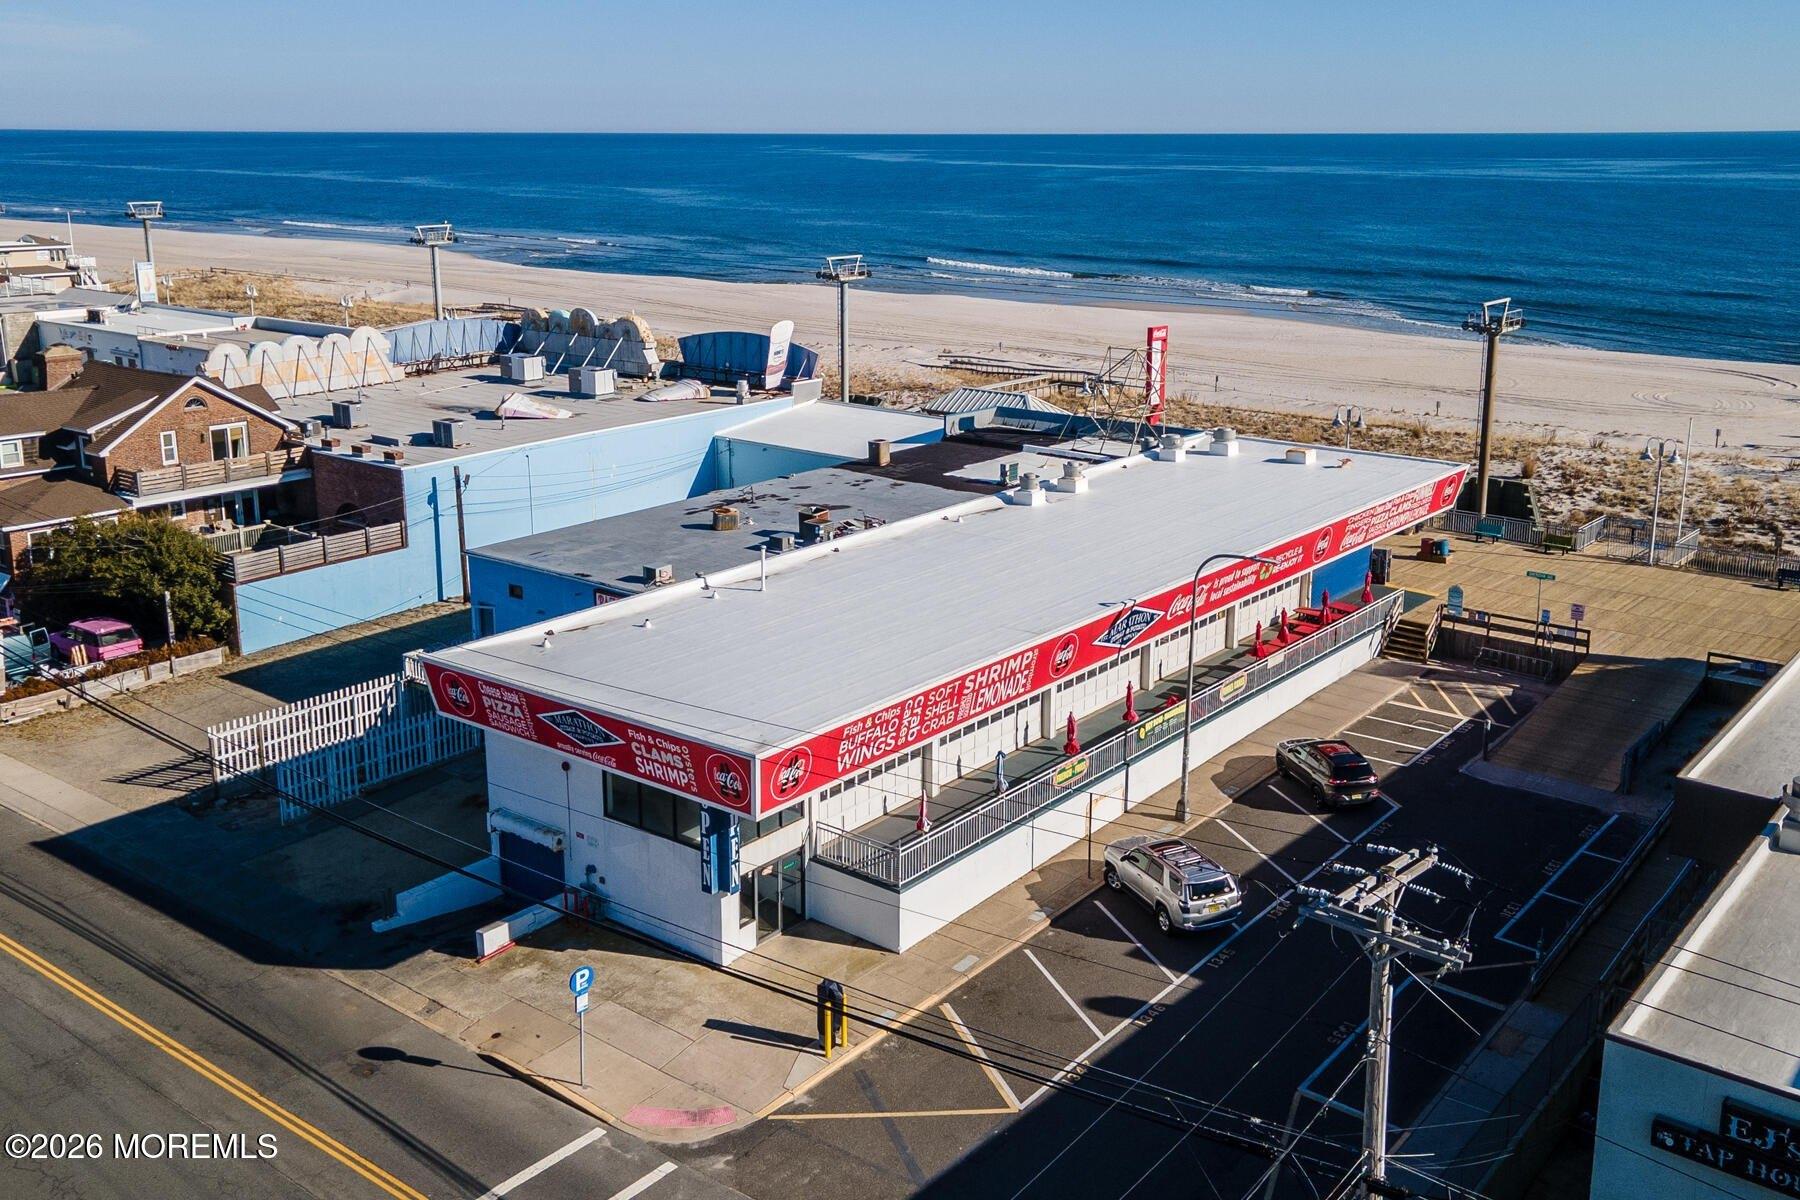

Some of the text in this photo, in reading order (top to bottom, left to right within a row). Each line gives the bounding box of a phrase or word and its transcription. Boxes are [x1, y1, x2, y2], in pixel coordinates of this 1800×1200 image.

[1389, 500, 1412, 516] CLAMS
[1210, 574, 1257, 602] local sustainability
[1218, 570, 1236, 588] proud
[1241, 563, 1261, 579] support
[963, 651, 1034, 694] SHRIMP
[477, 680, 502, 697] Cheese
[927, 680, 961, 704] SOFT
[969, 669, 1030, 715] LEMONADE
[482, 696, 525, 719] PIZZA
[485, 708, 529, 729] SAUSAGE
[924, 696, 959, 720] SHELL
[489, 718, 531, 737] SANDWICH
[554, 714, 606, 738] MARATHON
[842, 706, 901, 738] Fish & Chips
[921, 711, 955, 735] CRAB
[627, 728, 681, 754] Fish & Chips
[838, 718, 899, 755] BUFFALO
[631, 741, 685, 769] CLAMS
[836, 733, 897, 773] WINGS
[635, 756, 689, 787] SHRIMP
[681, 745, 698, 793] Oysters
[575, 968, 591, 992] P
[1134, 1004, 1167, 1028] 1346
[1679, 1133, 1735, 1169] TAP
